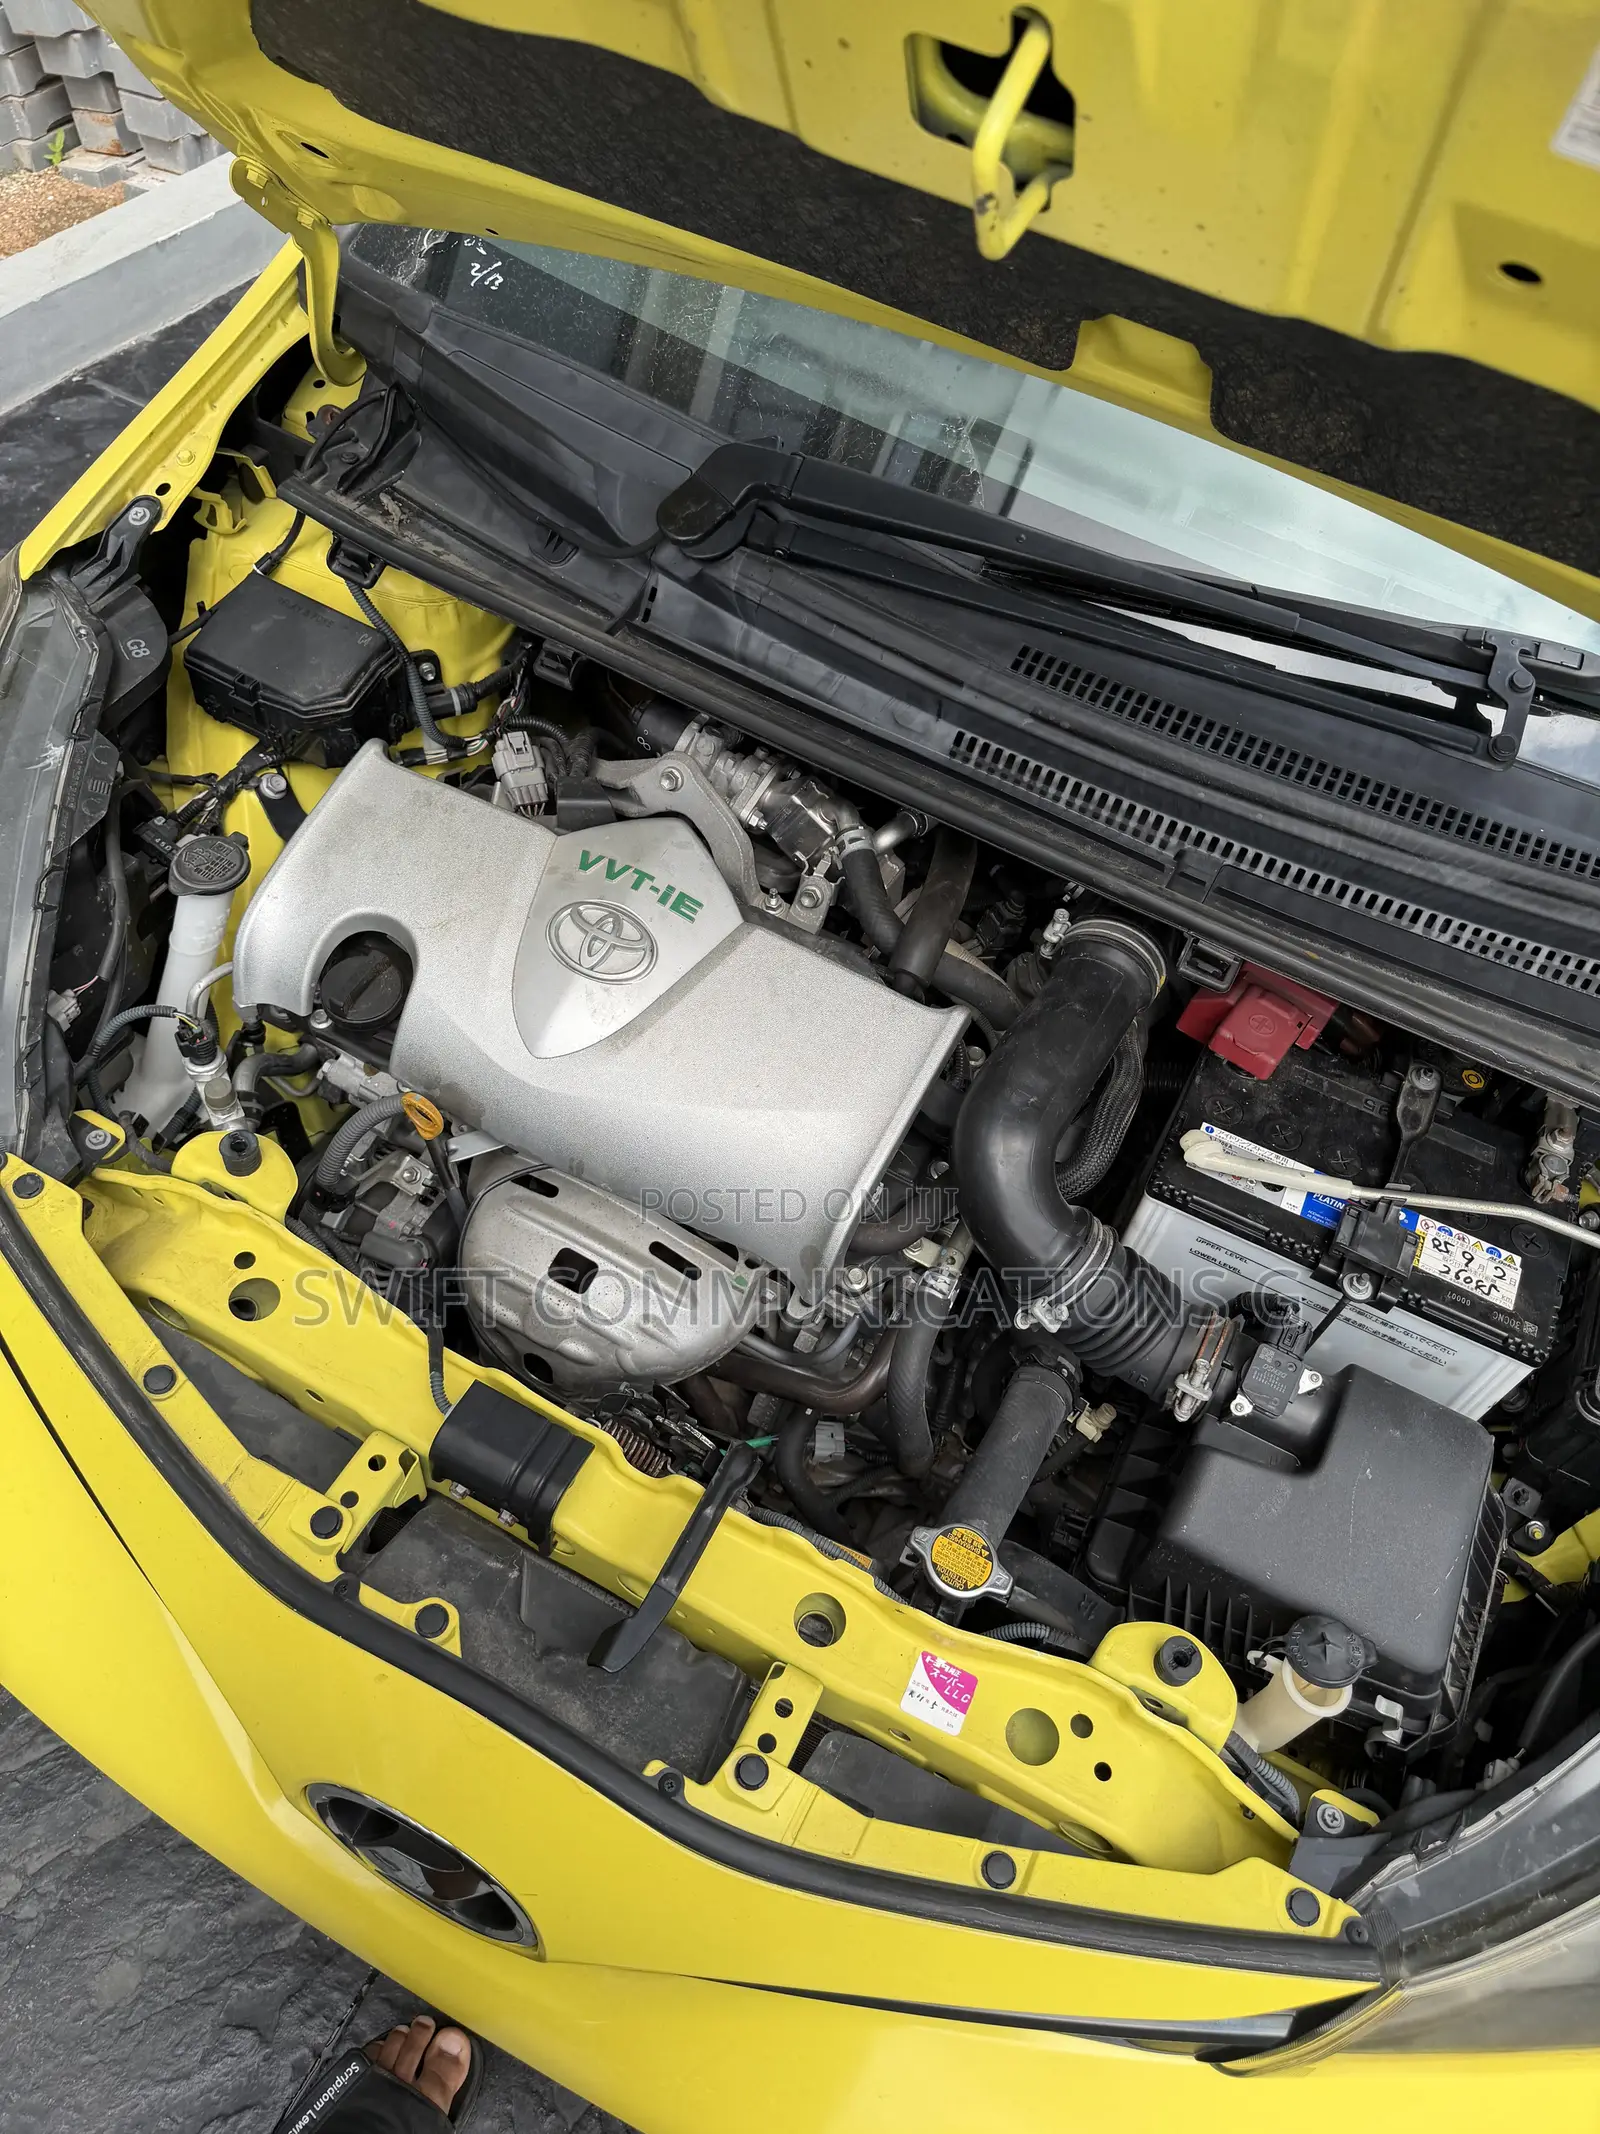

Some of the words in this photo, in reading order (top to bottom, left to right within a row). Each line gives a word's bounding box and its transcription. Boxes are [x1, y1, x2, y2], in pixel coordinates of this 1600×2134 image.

[1189, 1247, 1218, 1265] LOWER
[1217, 1260, 1243, 1275] LEVEL
[1196, 1237, 1222, 1252] UPPER
[1224, 1250, 1249, 1264] LEVEL
[936, 1564, 966, 1584] ATTENTION
[940, 1573, 964, 1590] CAUTION
[929, 1667, 965, 1689] スーパー
[944, 1685, 970, 1703] LLC
[313, 2061, 360, 2111] Scripidom
